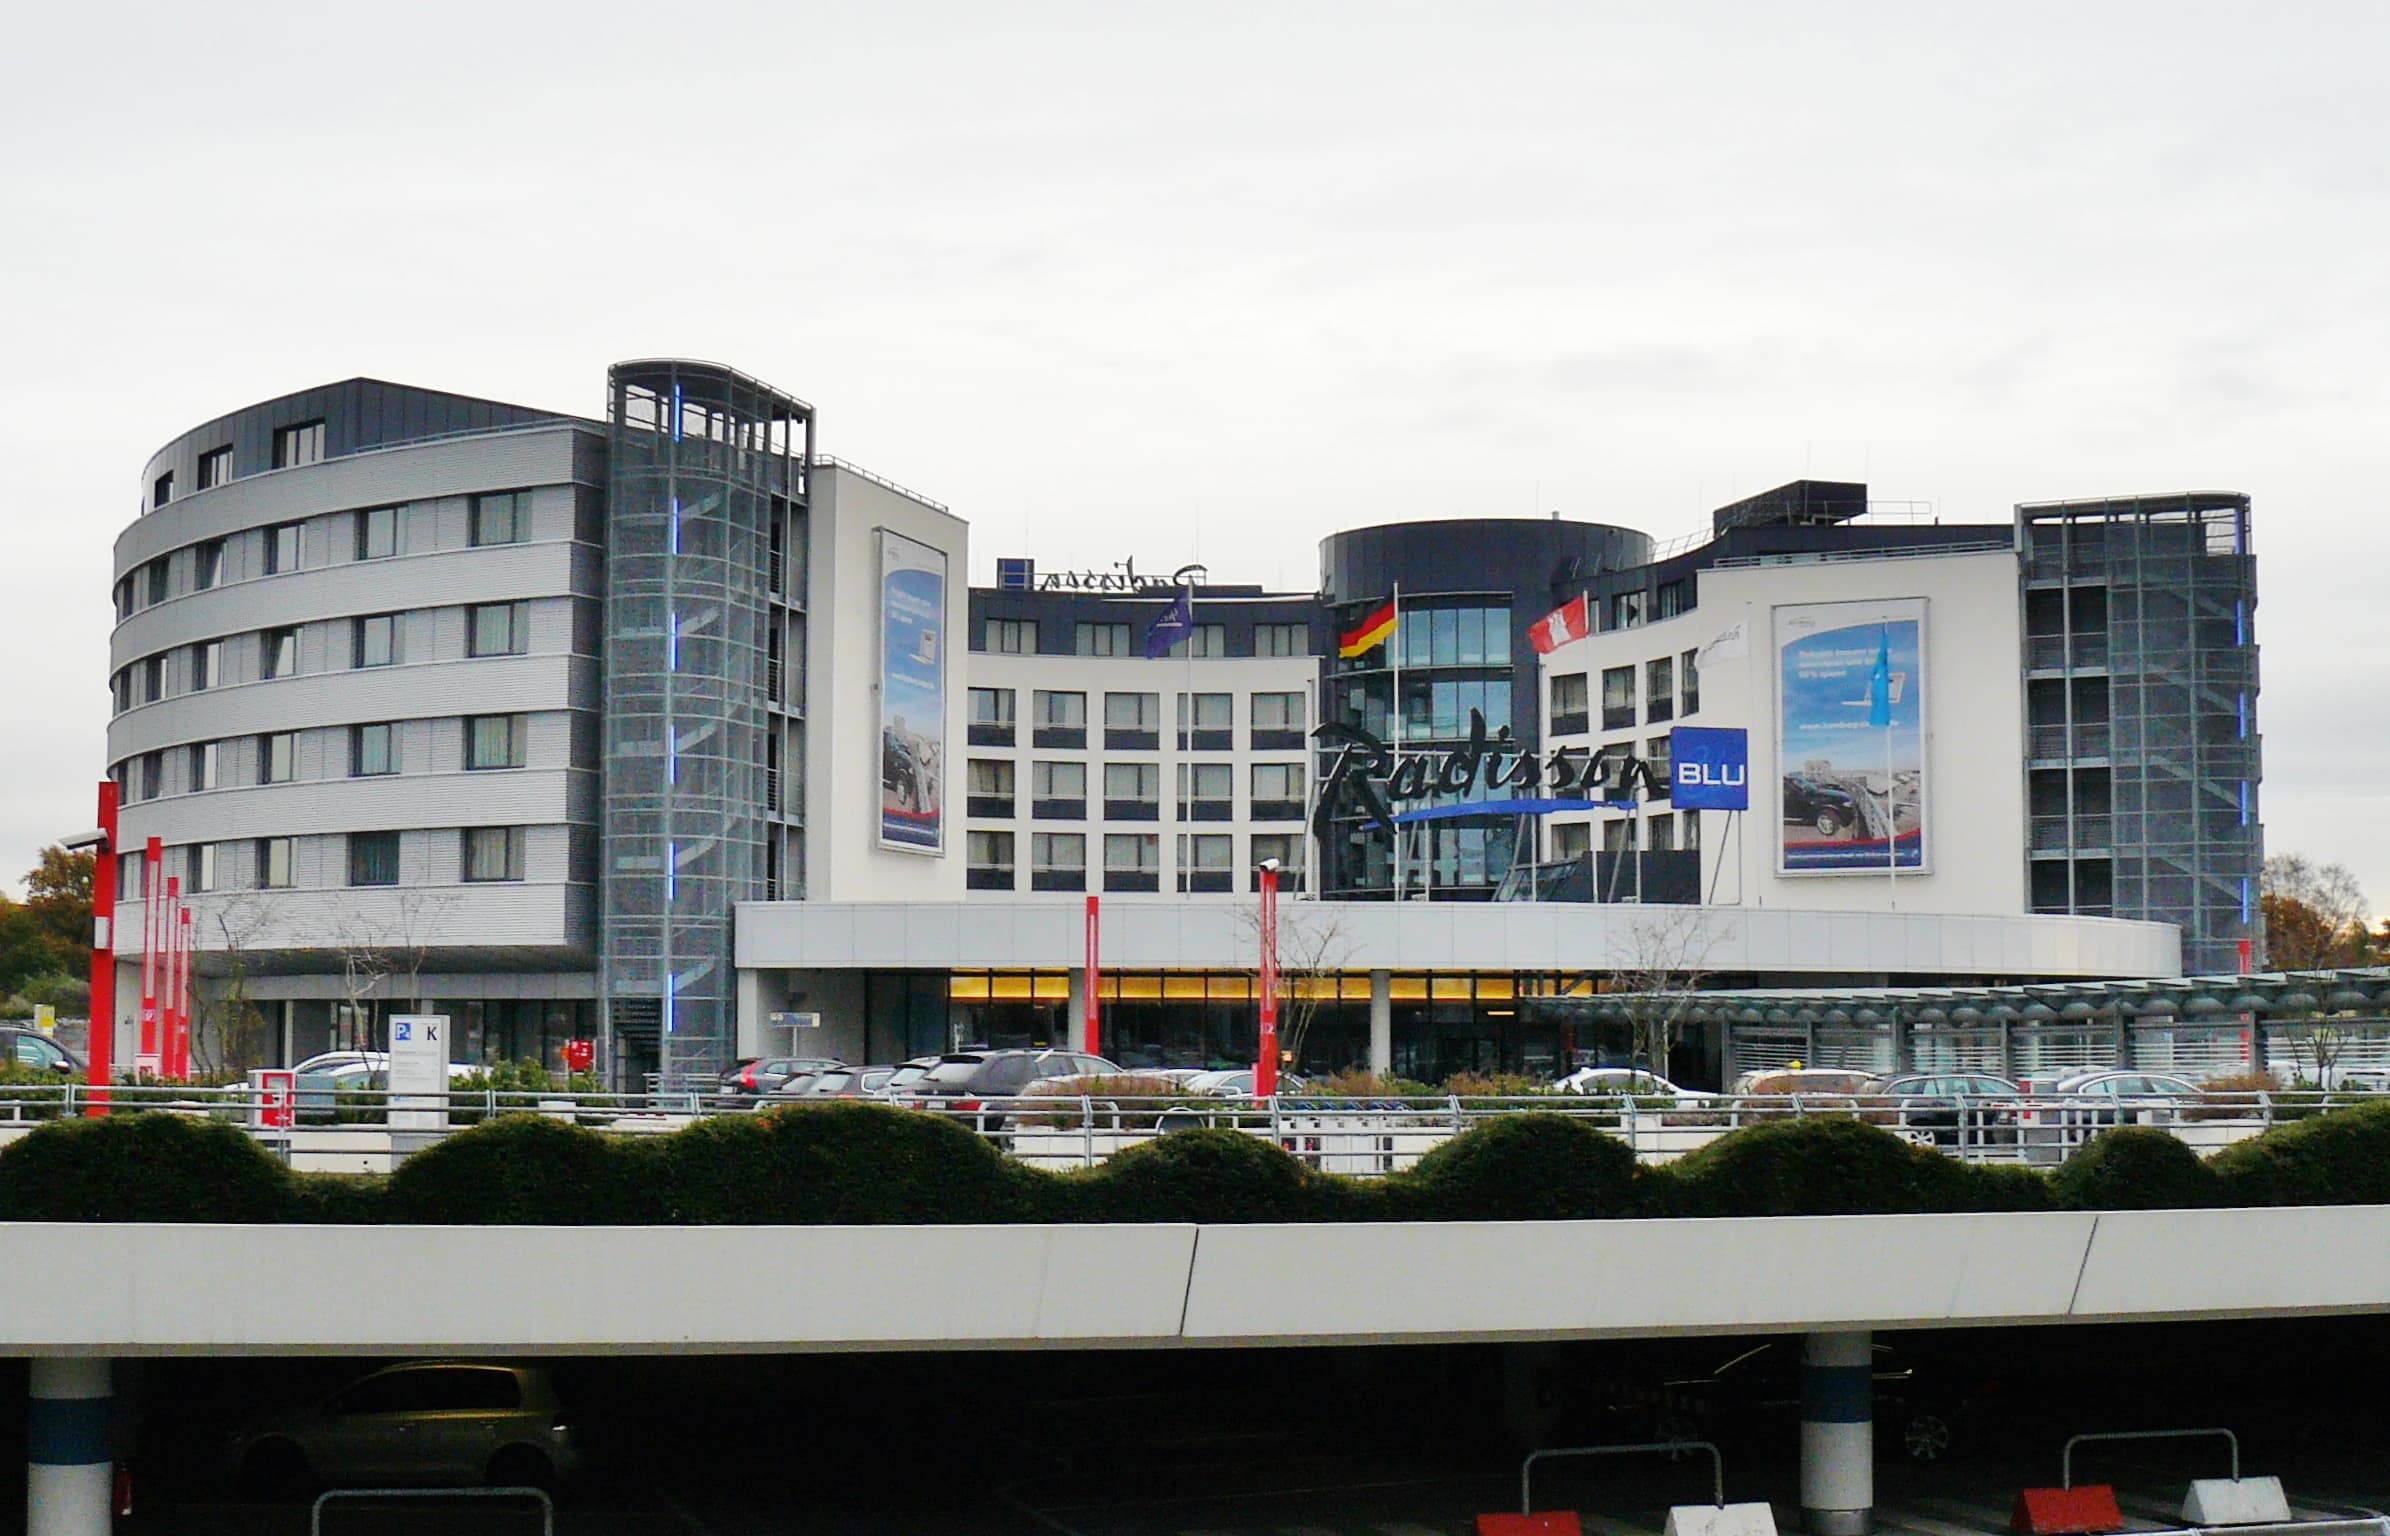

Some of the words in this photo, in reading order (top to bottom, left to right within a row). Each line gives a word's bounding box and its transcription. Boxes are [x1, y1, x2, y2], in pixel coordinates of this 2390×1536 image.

[1310, 706, 1671, 838] Radisson
[1678, 762, 1745, 786] BLU
[427, 1026, 438, 1041] K
